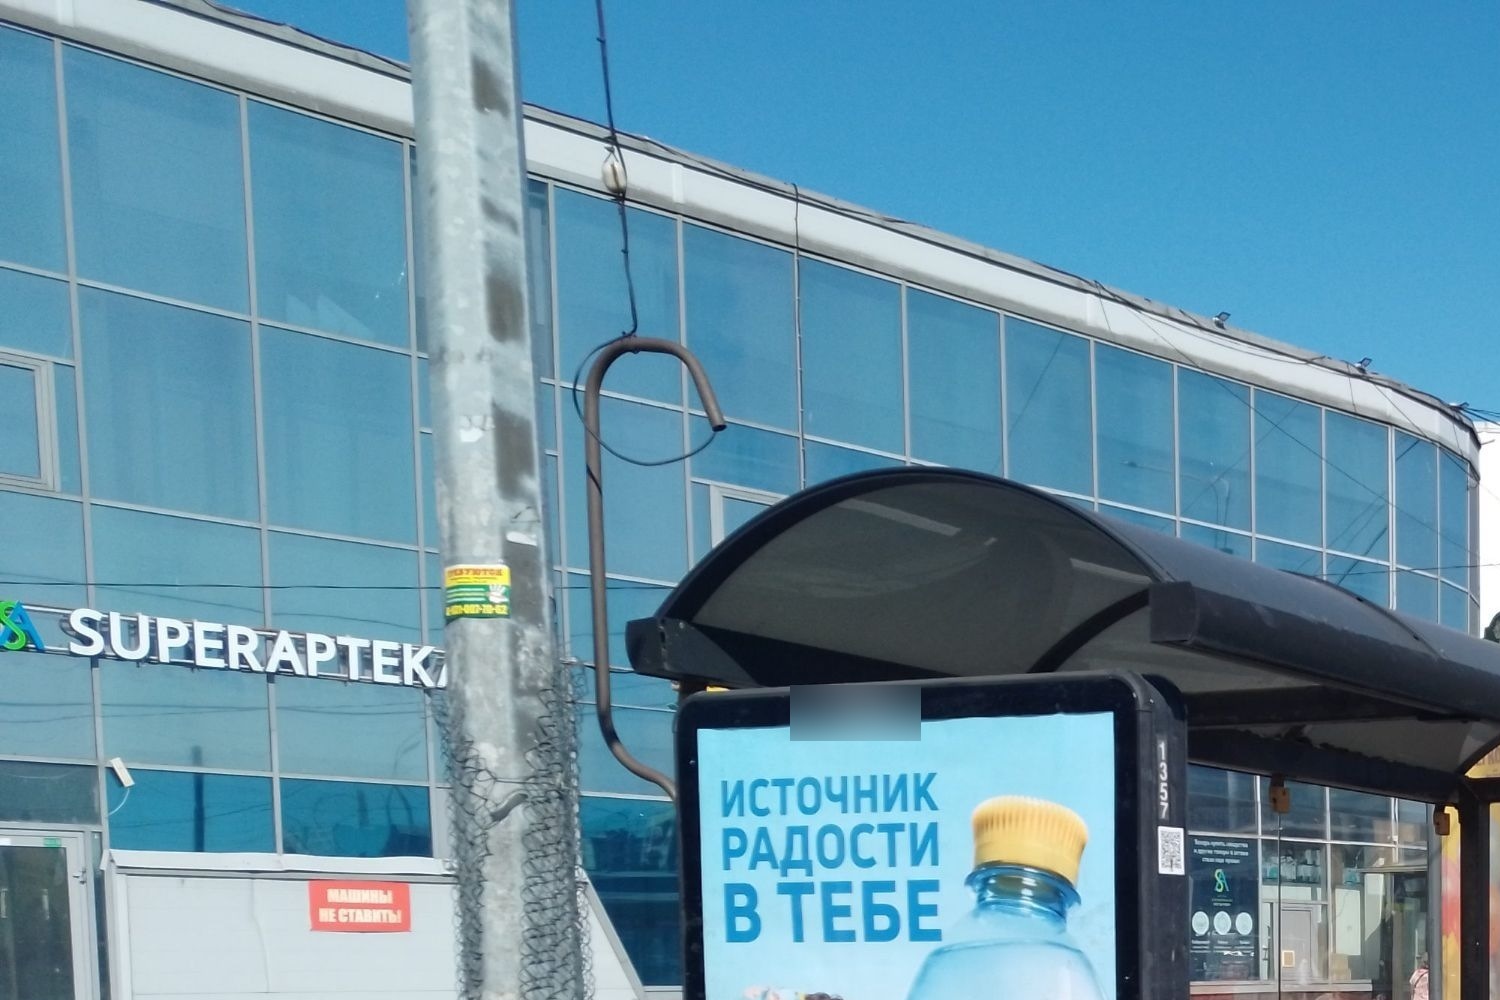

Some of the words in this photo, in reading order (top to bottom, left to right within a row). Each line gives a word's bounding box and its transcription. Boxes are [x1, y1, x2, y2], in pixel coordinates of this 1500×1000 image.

[721, 772, 939, 818] ИСТОЧНИК
[722, 821, 940, 877] РАДОСТИ
[318, 907, 337, 922] НЕ
[327, 888, 393, 904] МАШИНЫ
[724, 882, 761, 943] В
[776, 879, 943, 943] ТЕБЕ
